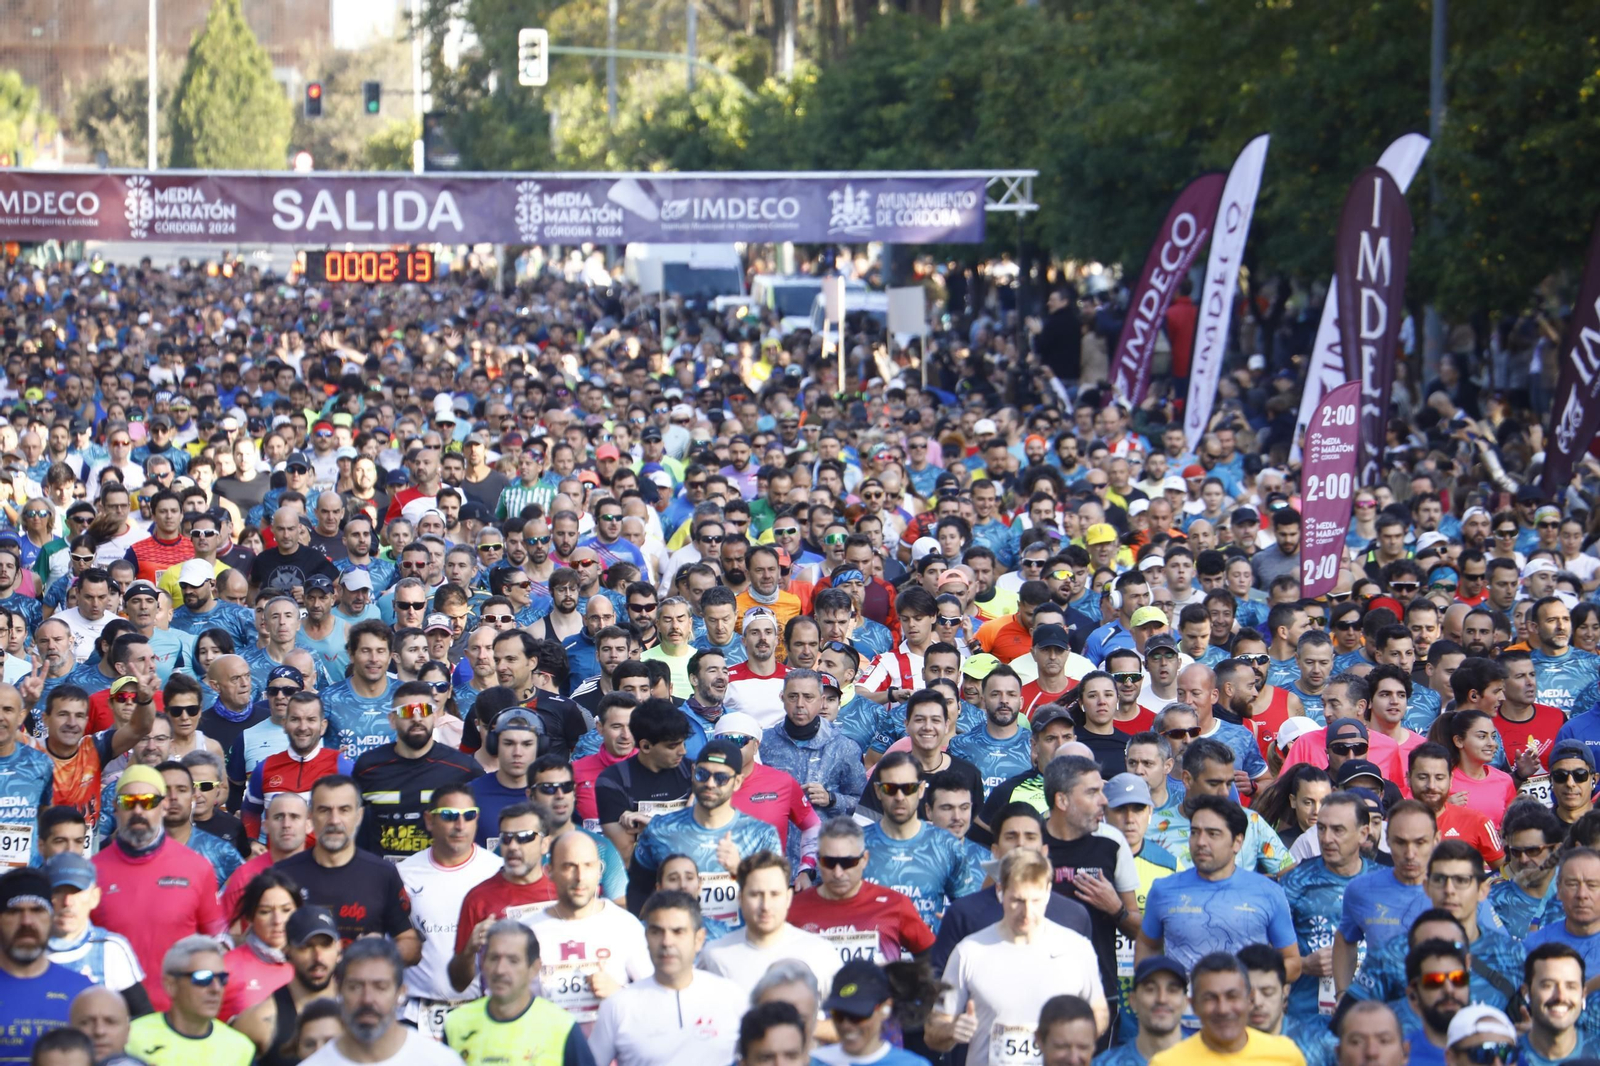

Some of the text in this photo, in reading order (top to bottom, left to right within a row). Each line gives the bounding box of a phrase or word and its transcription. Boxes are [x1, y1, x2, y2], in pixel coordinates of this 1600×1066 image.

[155, 187, 204, 203] MEDIA
[544, 192, 593, 207] MEDIA
[876, 191, 977, 210] AYUNTAMIENTO
[124, 199, 236, 220] 38 MARATÓN
[272, 188, 464, 233] SALIDA
[515, 202, 623, 224] 38 MARATÓN
[693, 197, 800, 220] IMDECO
[876, 211, 893, 226] DE
[209, 222, 236, 234] 2024
[596, 226, 623, 237] 2024
[1121, 212, 1196, 371] IMDECO
[1321, 404, 1356, 426] 2:00
[1321, 437, 1341, 445] MEDIA
[1321, 442, 1354, 453] MARATÓN
[1306, 473, 1351, 502] 2:00
[1316, 521, 1337, 530] MEDIA
[1538, 689, 1571, 698] MEDIA
[1543, 699, 1575, 708] MARAT
[356, 735, 391, 745] MEDIA
[697, 886, 736, 904] 700
[339, 902, 366, 922] edp
